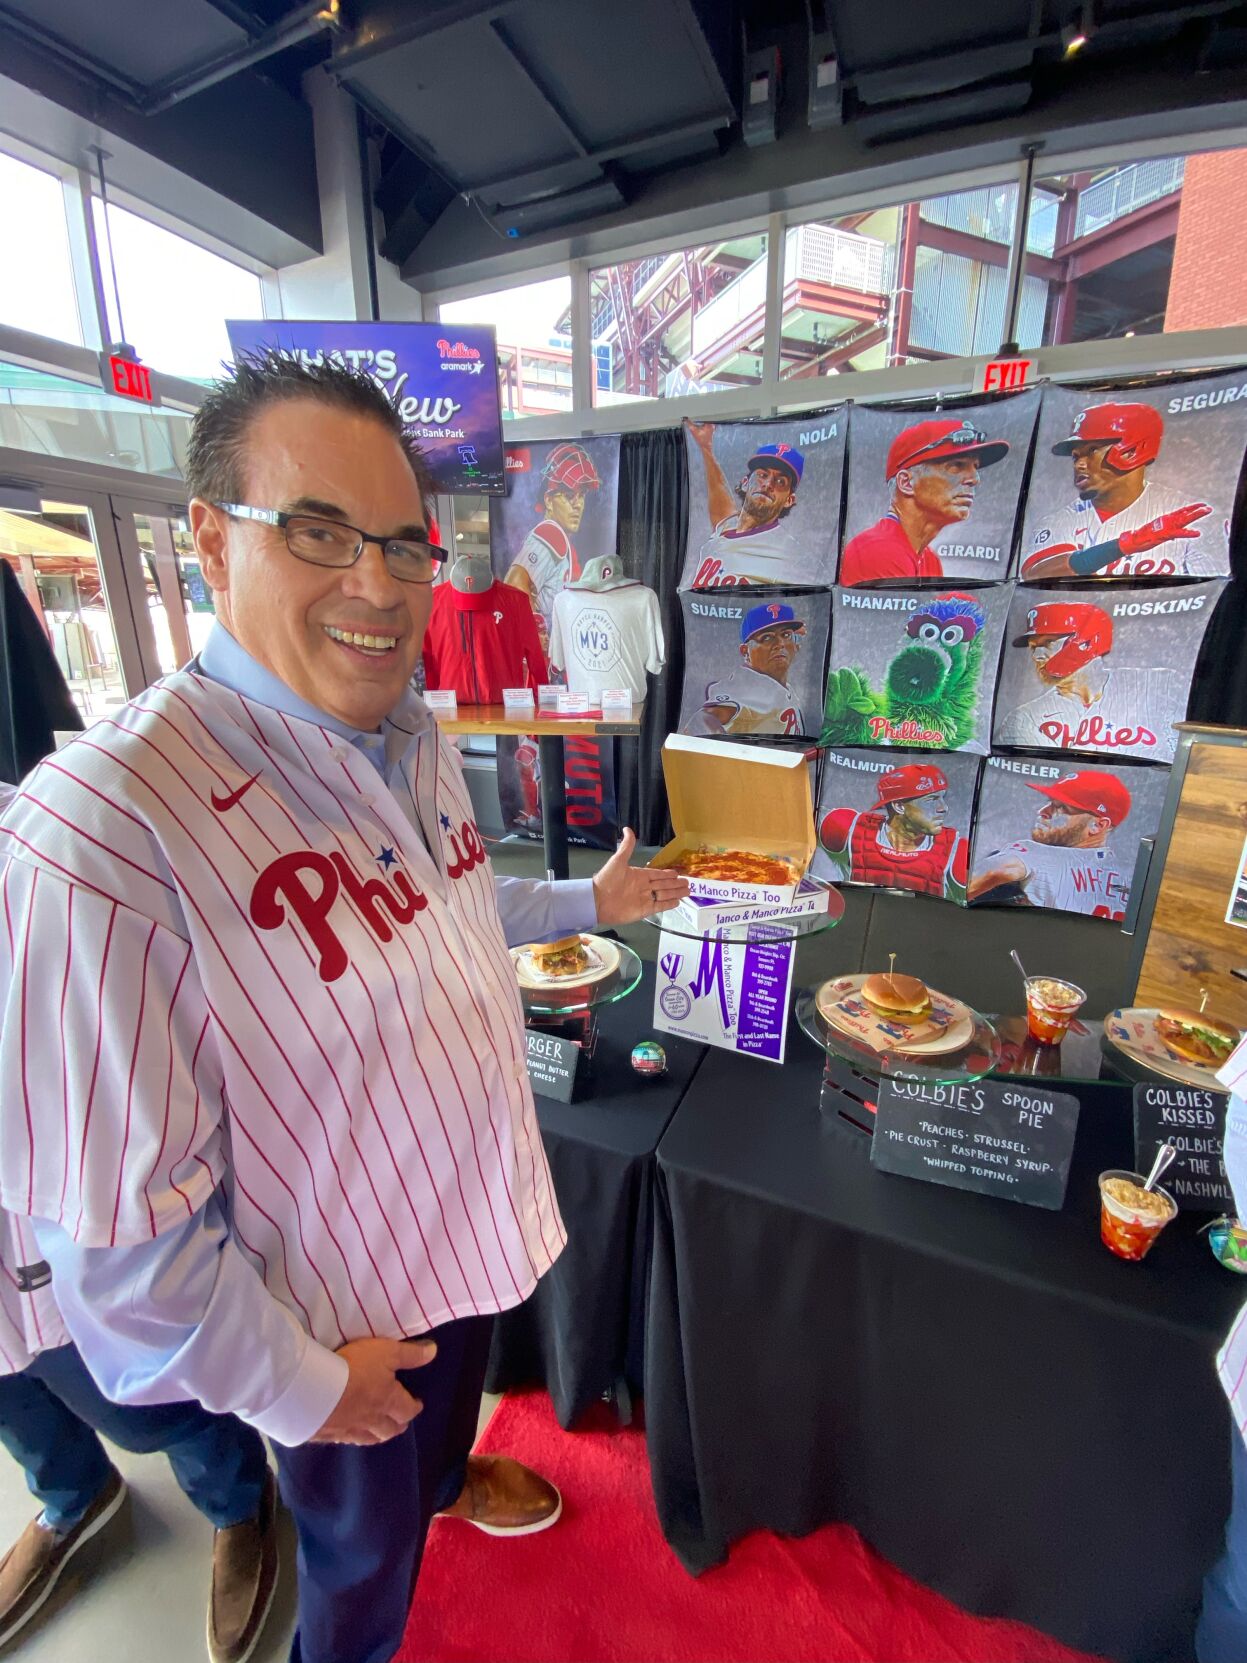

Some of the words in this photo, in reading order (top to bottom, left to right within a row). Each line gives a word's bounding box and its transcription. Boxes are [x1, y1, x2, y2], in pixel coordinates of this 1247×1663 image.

[436, 339, 481, 359] Phillies
[440, 362, 472, 371] aramark
[983, 359, 1031, 393] EXIT
[109, 355, 153, 401] EXIT
[1167, 383, 1247, 414] SEGURA
[422, 428, 444, 438] Bank
[445, 429, 465, 438] Park
[800, 423, 838, 446] NOLA
[938, 544, 1000, 562] GIRARDI
[690, 602, 743, 619] SUÁREZ
[842, 594, 918, 611] PHANATIC
[1112, 595, 1206, 617] HOSKINS
[869, 716, 943, 743] Phillies
[829, 752, 896, 774] REALMUTO
[987, 757, 1060, 779] WHEELER
[699, 884, 729, 897] Manco
[731, 887, 757, 900] Pizza
[763, 890, 781, 903] Too
[742, 910, 750, 921] &
[751, 909, 779, 922] Manco
[723, 964, 732, 991] Manco
[754, 1031, 765, 1039] Last
[525, 1035, 562, 1060] RGER
[892, 1070, 985, 1111] COLBIE'S
[1001, 1092, 1054, 1115] SPOON
[1146, 1088, 1213, 1109] COLBIE'S
[1018, 1110, 1044, 1129] PIE
[1161, 1107, 1216, 1125] KISSED
[889, 1131, 904, 1142] PIE
[908, 1134, 939, 1148] CRUST
[951, 1144, 1009, 1165] RASPBERRY
[1188, 1158, 1211, 1176] THE
